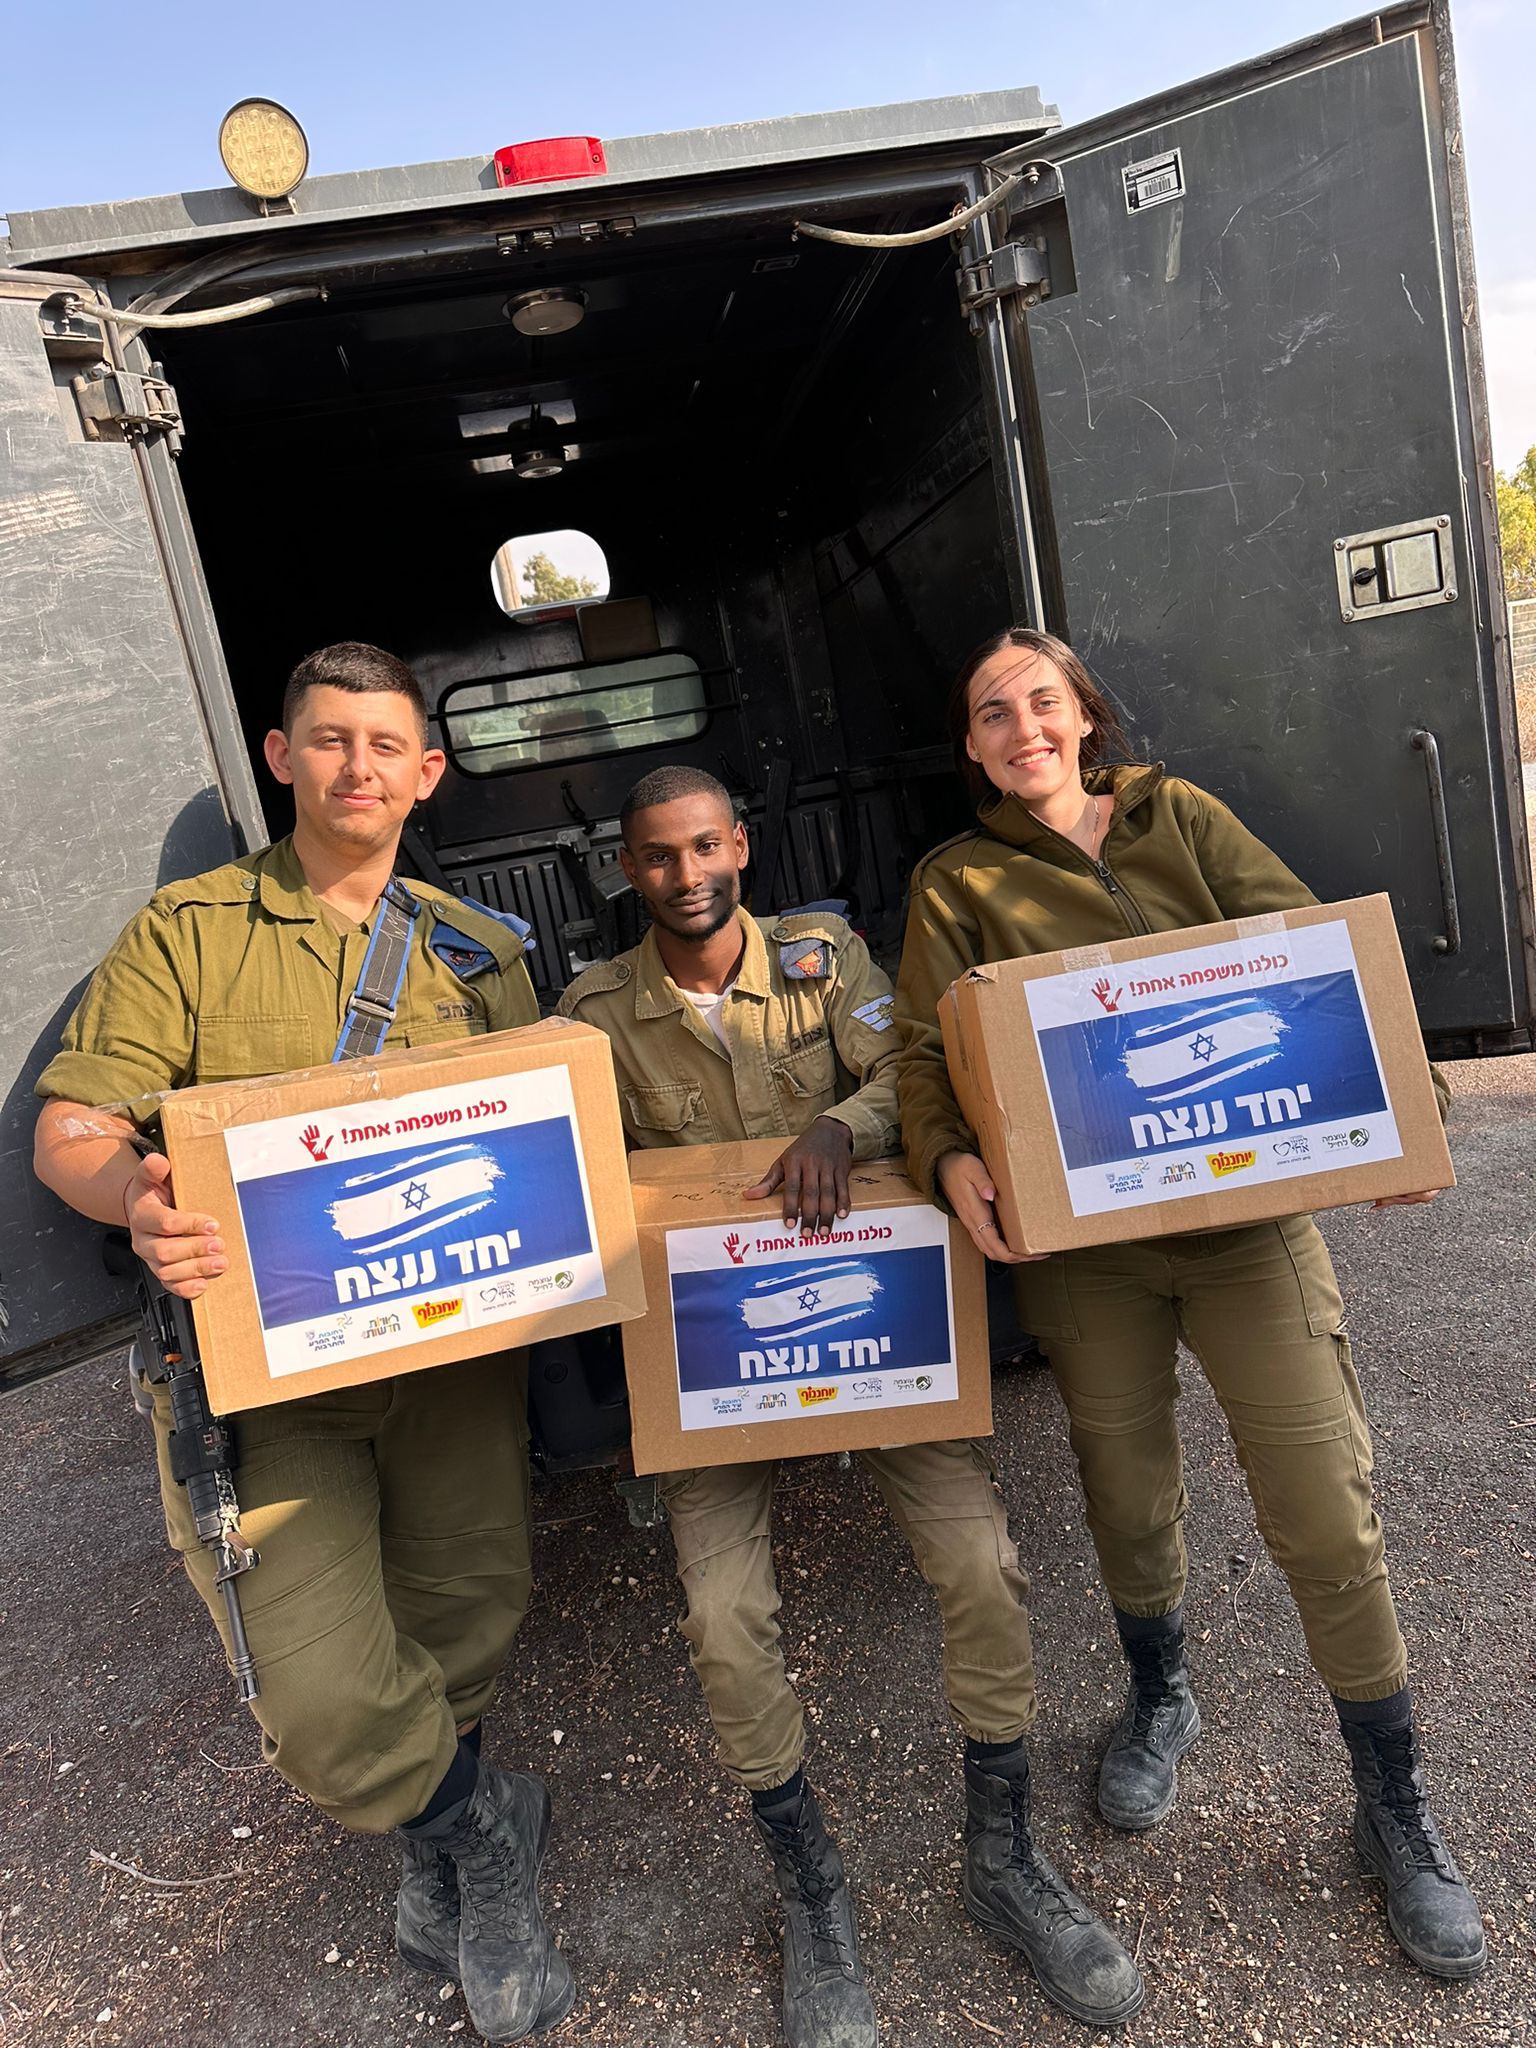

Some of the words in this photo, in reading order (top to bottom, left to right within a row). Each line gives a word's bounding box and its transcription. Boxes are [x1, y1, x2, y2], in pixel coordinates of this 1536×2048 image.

[1178, 961, 1245, 988] משפחה
[1247, 953, 1289, 973] כולנו
[1129, 975, 1177, 997] אחת!
[467, 1099, 508, 1120] כולנו
[1234, 1083, 1312, 1127] יחד
[341, 1122, 391, 1145] אחת!
[395, 1109, 463, 1135] משפחה
[1129, 1099, 1228, 1149] ננצח
[1211, 1151, 1252, 1170] יוחננוף
[756, 1237, 795, 1252] אחת!
[858, 1226, 892, 1240] כולנו
[444, 1229, 521, 1275] יחד
[334, 1249, 437, 1304] ננצח
[417, 1299, 458, 1320] יוחננוף
[738, 1344, 820, 1379] ננצח
[828, 1336, 891, 1368] יחד
[801, 1386, 835, 1401] יוחננוף
